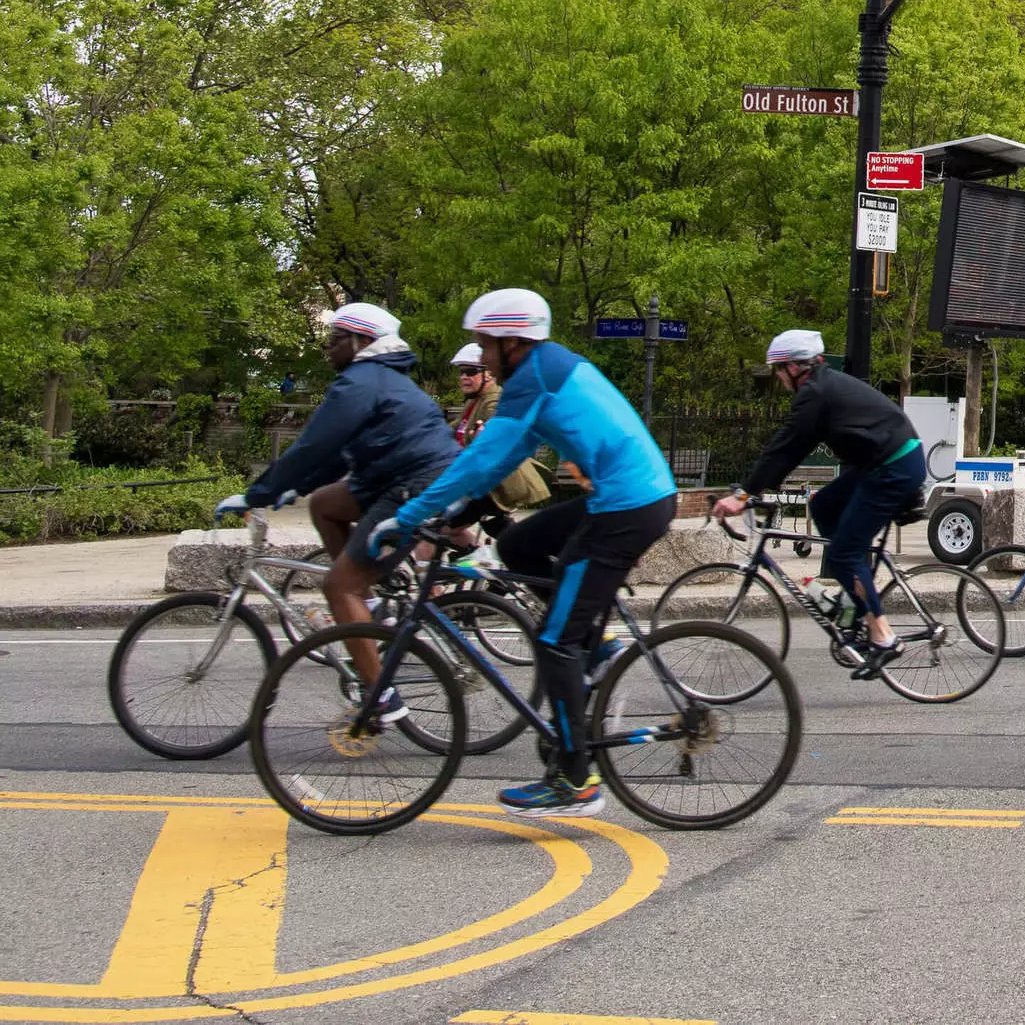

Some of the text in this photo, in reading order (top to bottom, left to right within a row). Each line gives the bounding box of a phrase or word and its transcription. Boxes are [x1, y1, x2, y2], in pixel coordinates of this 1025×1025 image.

[743, 92, 849, 114] Old Fulton St
[871, 156, 914, 165] NO STOPPING
[871, 165, 898, 173] Anytime
[866, 211, 890, 224] YOU IDLE
[866, 222, 889, 234] YOU PAY
